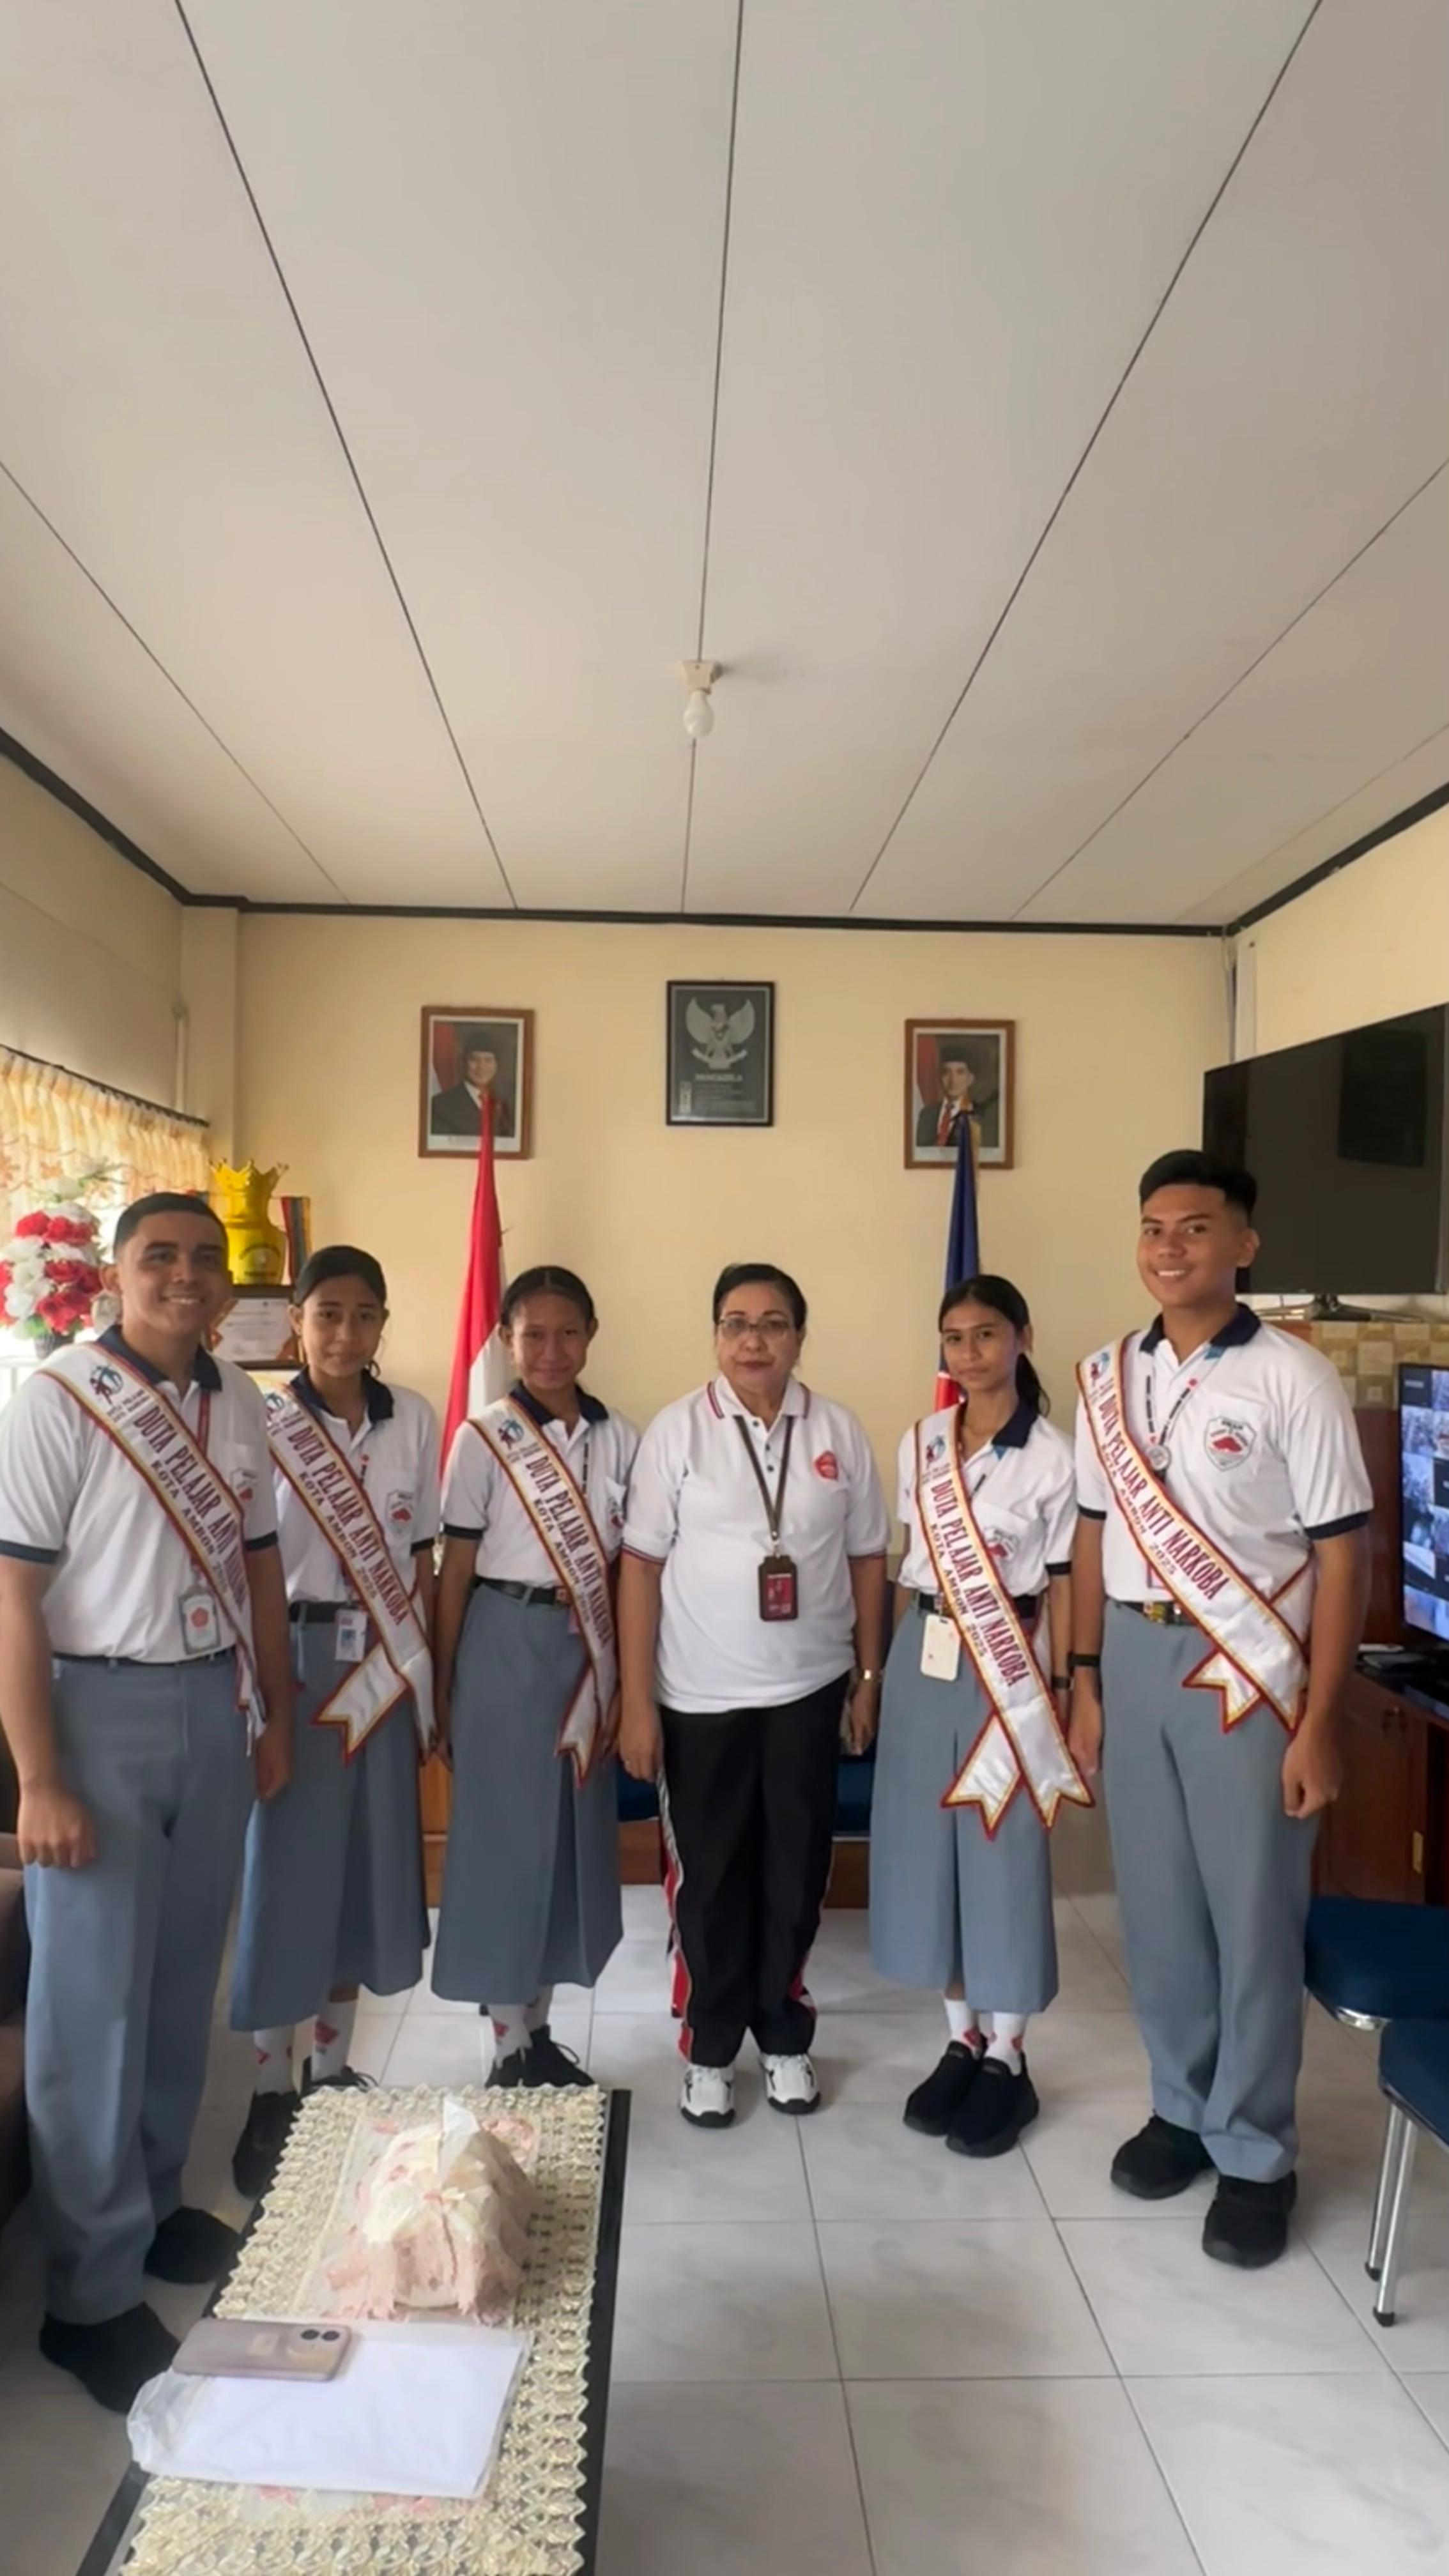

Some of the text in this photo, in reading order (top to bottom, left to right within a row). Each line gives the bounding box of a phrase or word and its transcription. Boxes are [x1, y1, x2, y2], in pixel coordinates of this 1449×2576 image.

[133, 1406, 178, 1453] DUTA
[164, 1445, 222, 1519] PELAJAR
[298, 1471, 325, 1506] KOTA
[288, 1425, 410, 1626] DUTA PELAJAR ANTI NARKOBA
[525, 1455, 562, 1493] DUTA
[546, 1490, 590, 1553] PELAJAR
[931, 1478, 959, 1518] DUTA
[1107, 1430, 1149, 1500] PELAJAR
[1139, 1495, 1175, 1536] ANTI
[1162, 1529, 1231, 1600] NARKOBA
[930, 1524, 945, 1560] KOTA
[941, 1517, 983, 1583] PELAJAR
[1149, 1543, 1177, 1575] 2025
[964, 1584, 1000, 1619] ANTI
[981, 1618, 1031, 1688] NARKOBA
